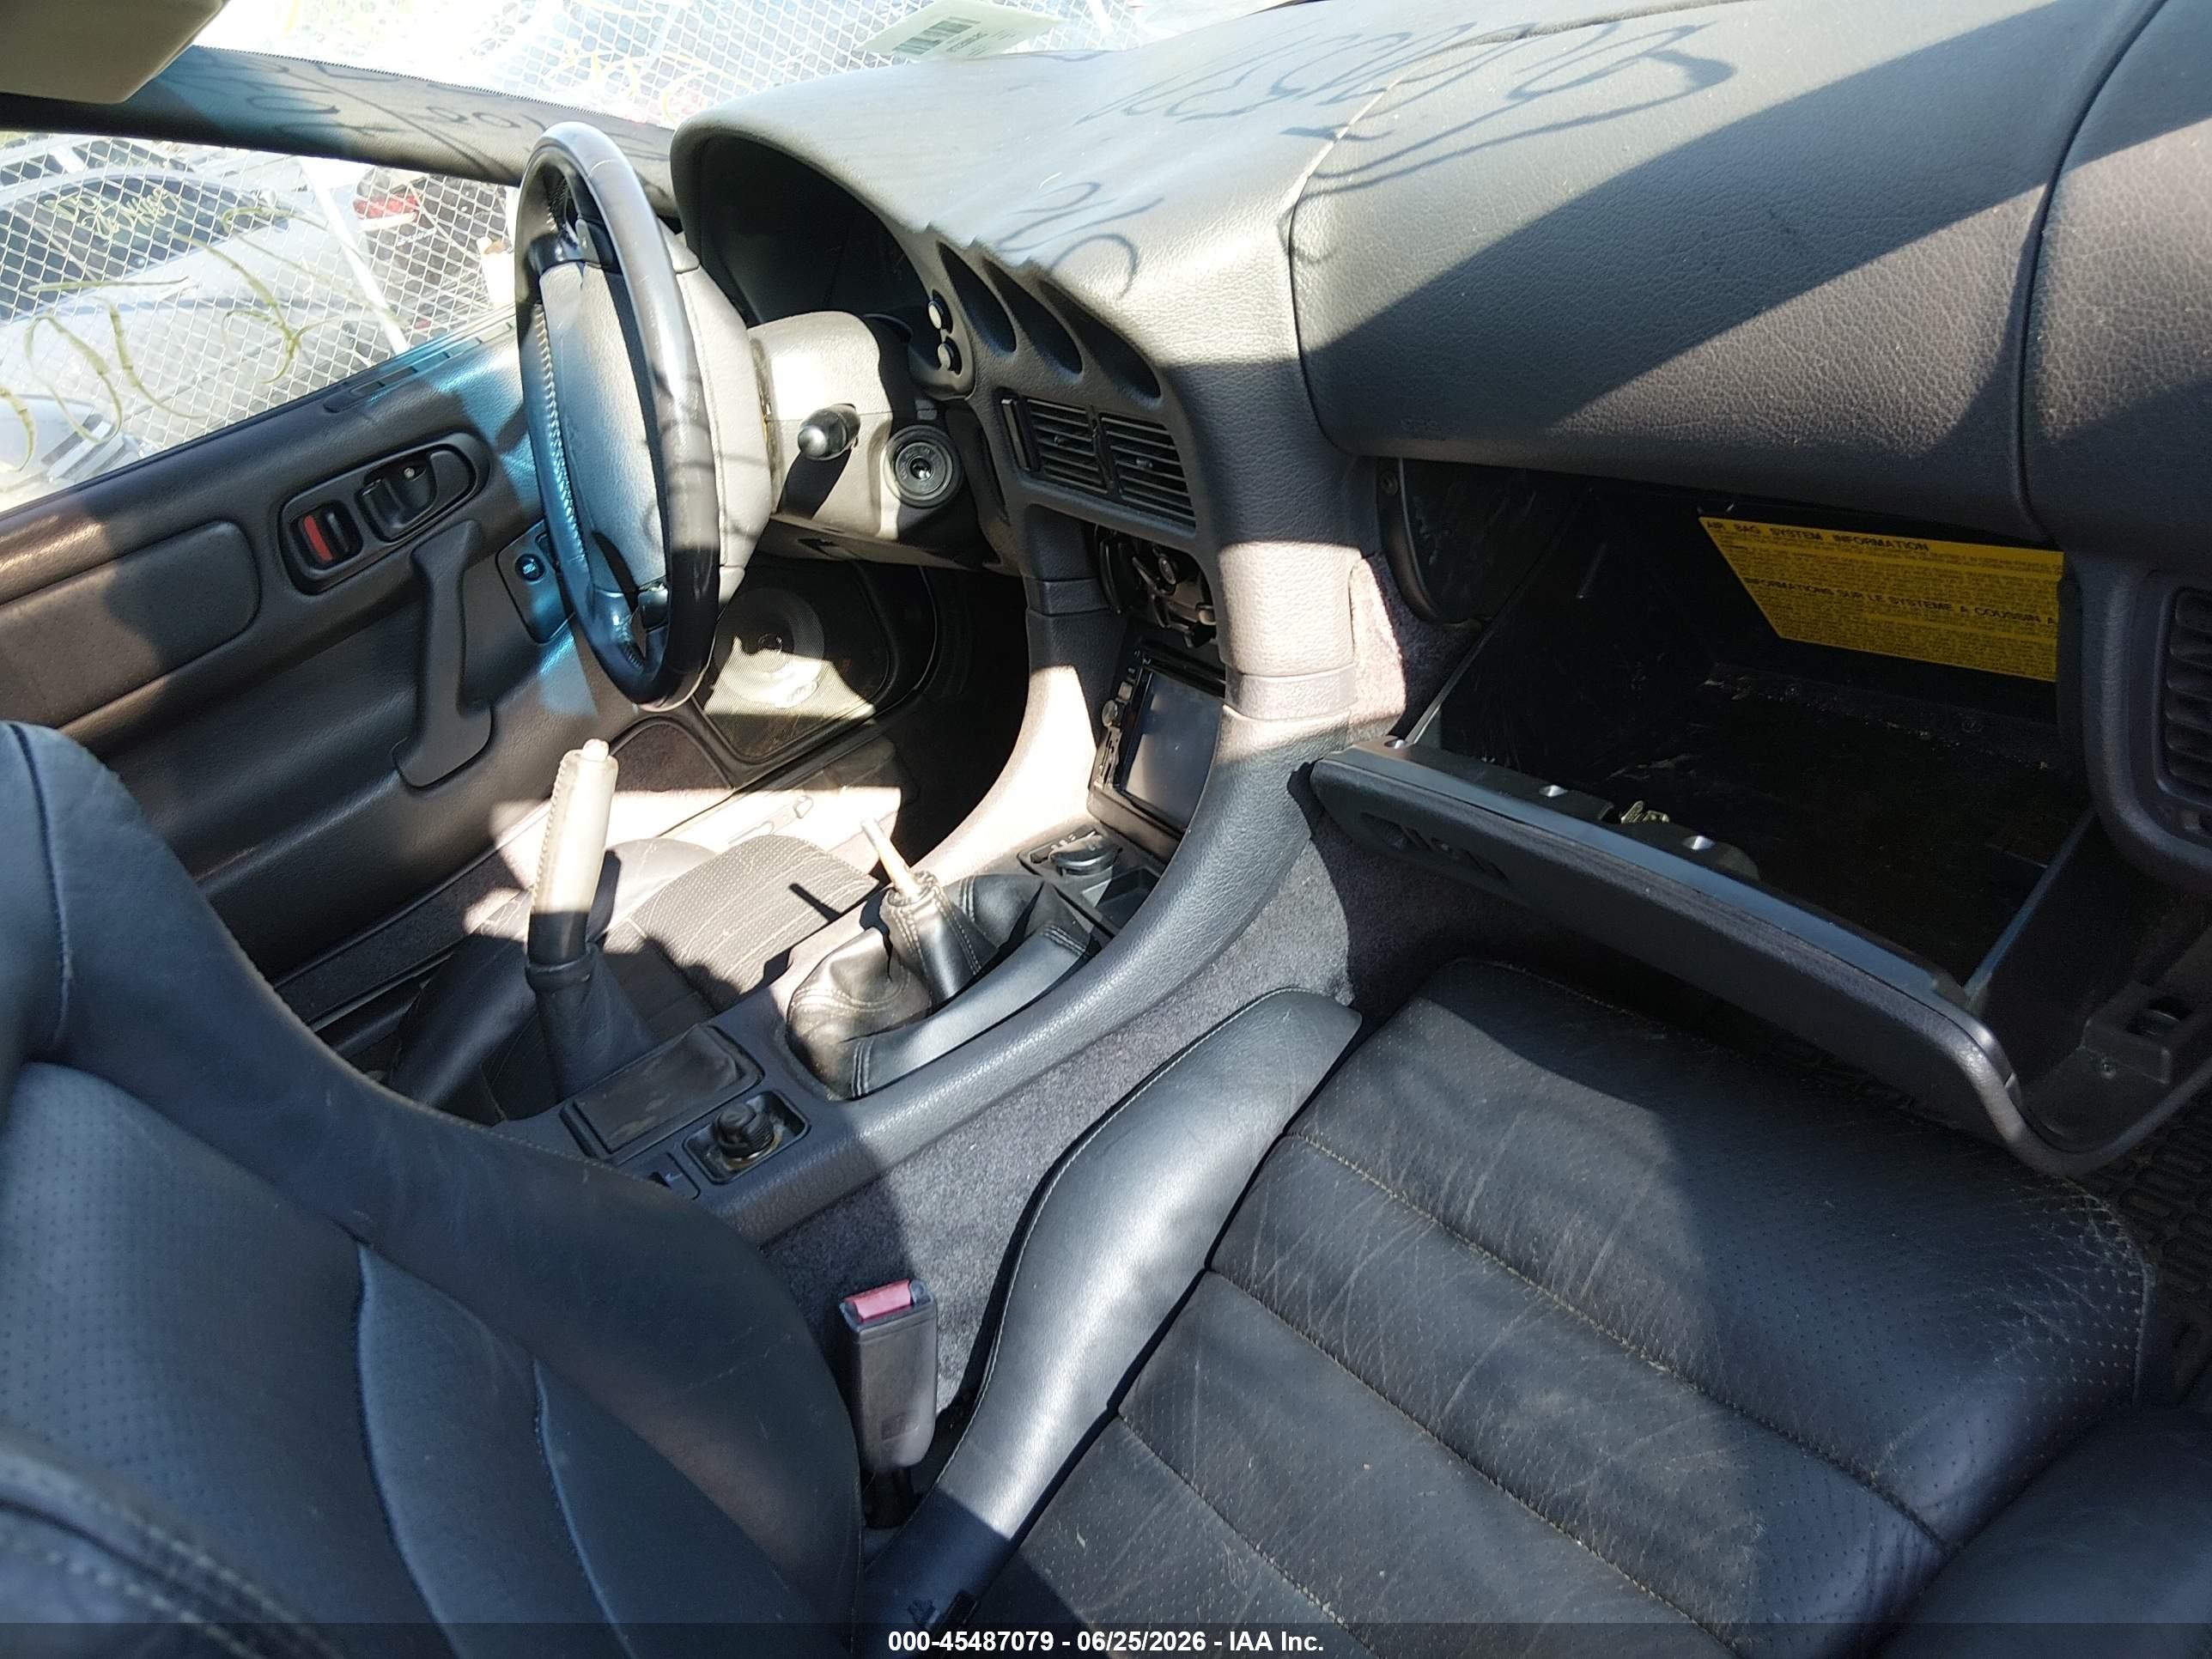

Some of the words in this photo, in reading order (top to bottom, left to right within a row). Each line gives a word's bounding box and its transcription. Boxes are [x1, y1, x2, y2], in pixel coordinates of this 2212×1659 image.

[1706, 521, 1725, 530] AIR
[1733, 524, 1760, 533] BAG
[1769, 527, 1823, 541] SYSTEM
[1832, 534, 1929, 551] INFORMATION
[1974, 606, 2041, 623] COUSSIN
